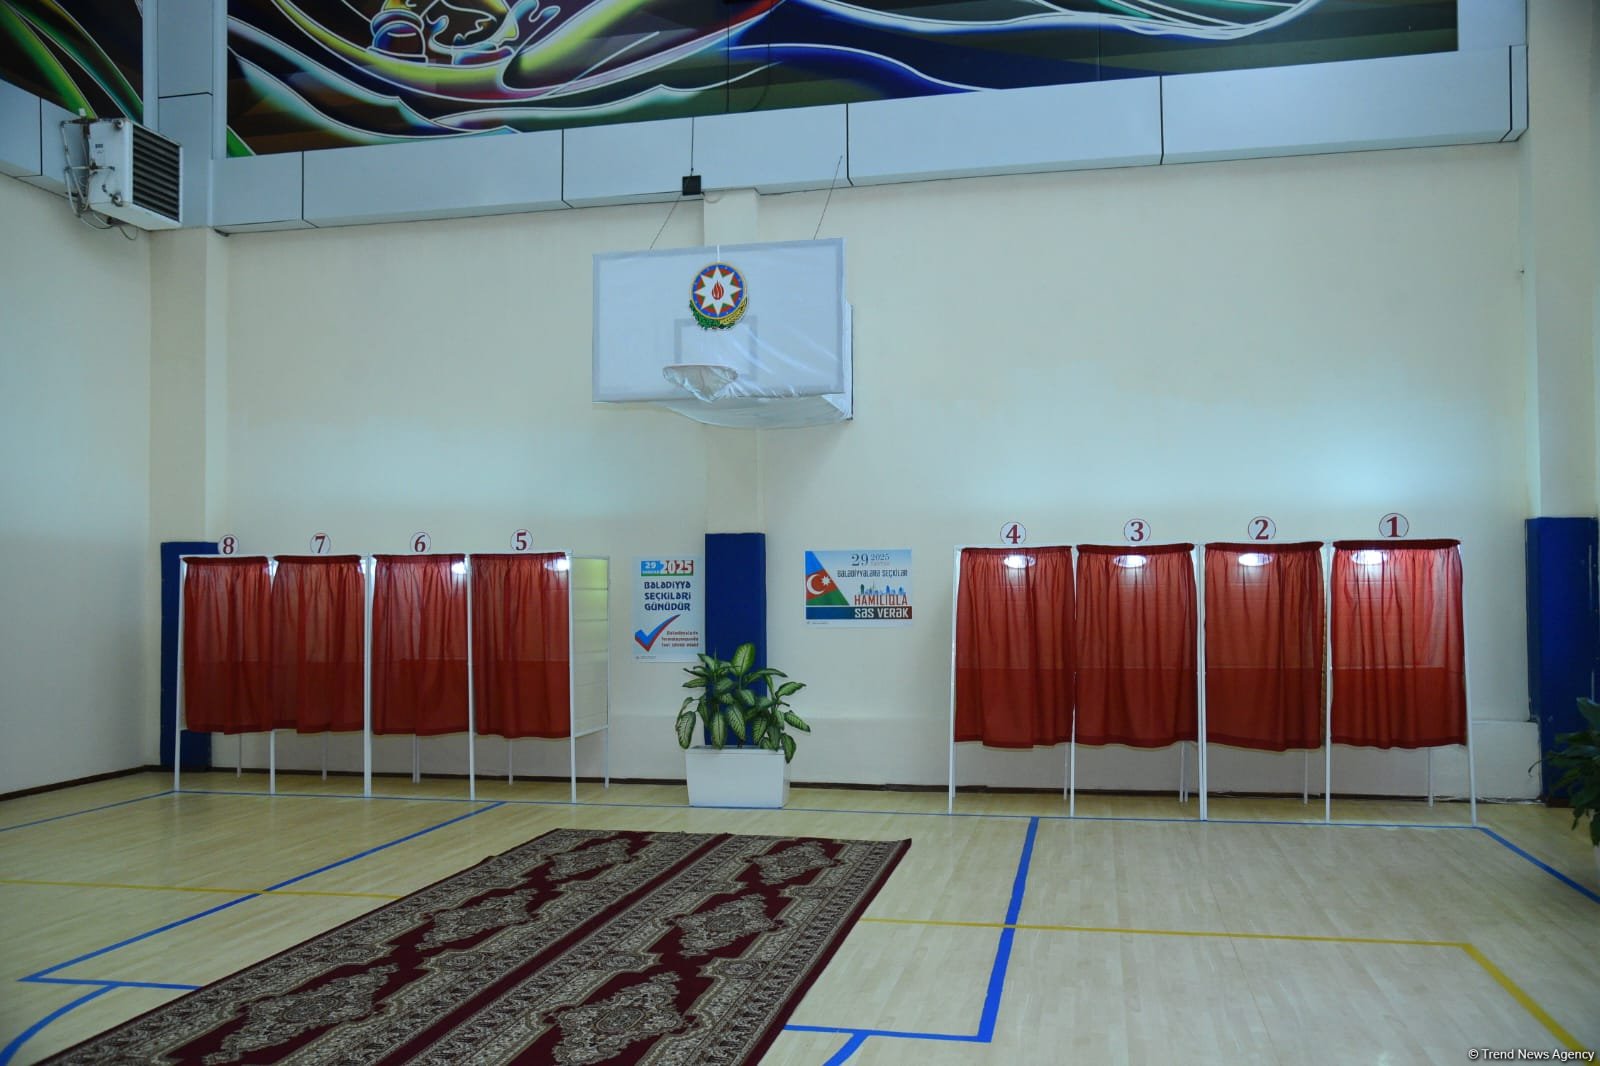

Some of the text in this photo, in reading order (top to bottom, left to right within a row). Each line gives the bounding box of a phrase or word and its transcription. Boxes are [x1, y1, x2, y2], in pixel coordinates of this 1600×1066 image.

[1005, 524, 1021, 544] 4
[1130, 521, 1144, 542] 3
[1255, 519, 1270, 540] 2
[1386, 516, 1401, 538] 1
[223, 536, 235, 555] 8
[315, 535, 326, 554] 7
[414, 534, 426, 553] 6
[515, 532, 527, 551] 5
[662, 560, 692, 575] 2025
[851, 553, 868, 566] 29
[870, 553, 890, 561] 2025
[644, 602, 691, 611] GÜNÜDÜR
[854, 594, 908, 605] HAMILIQLA
[854, 608, 909, 618] SƏS VERƏK
